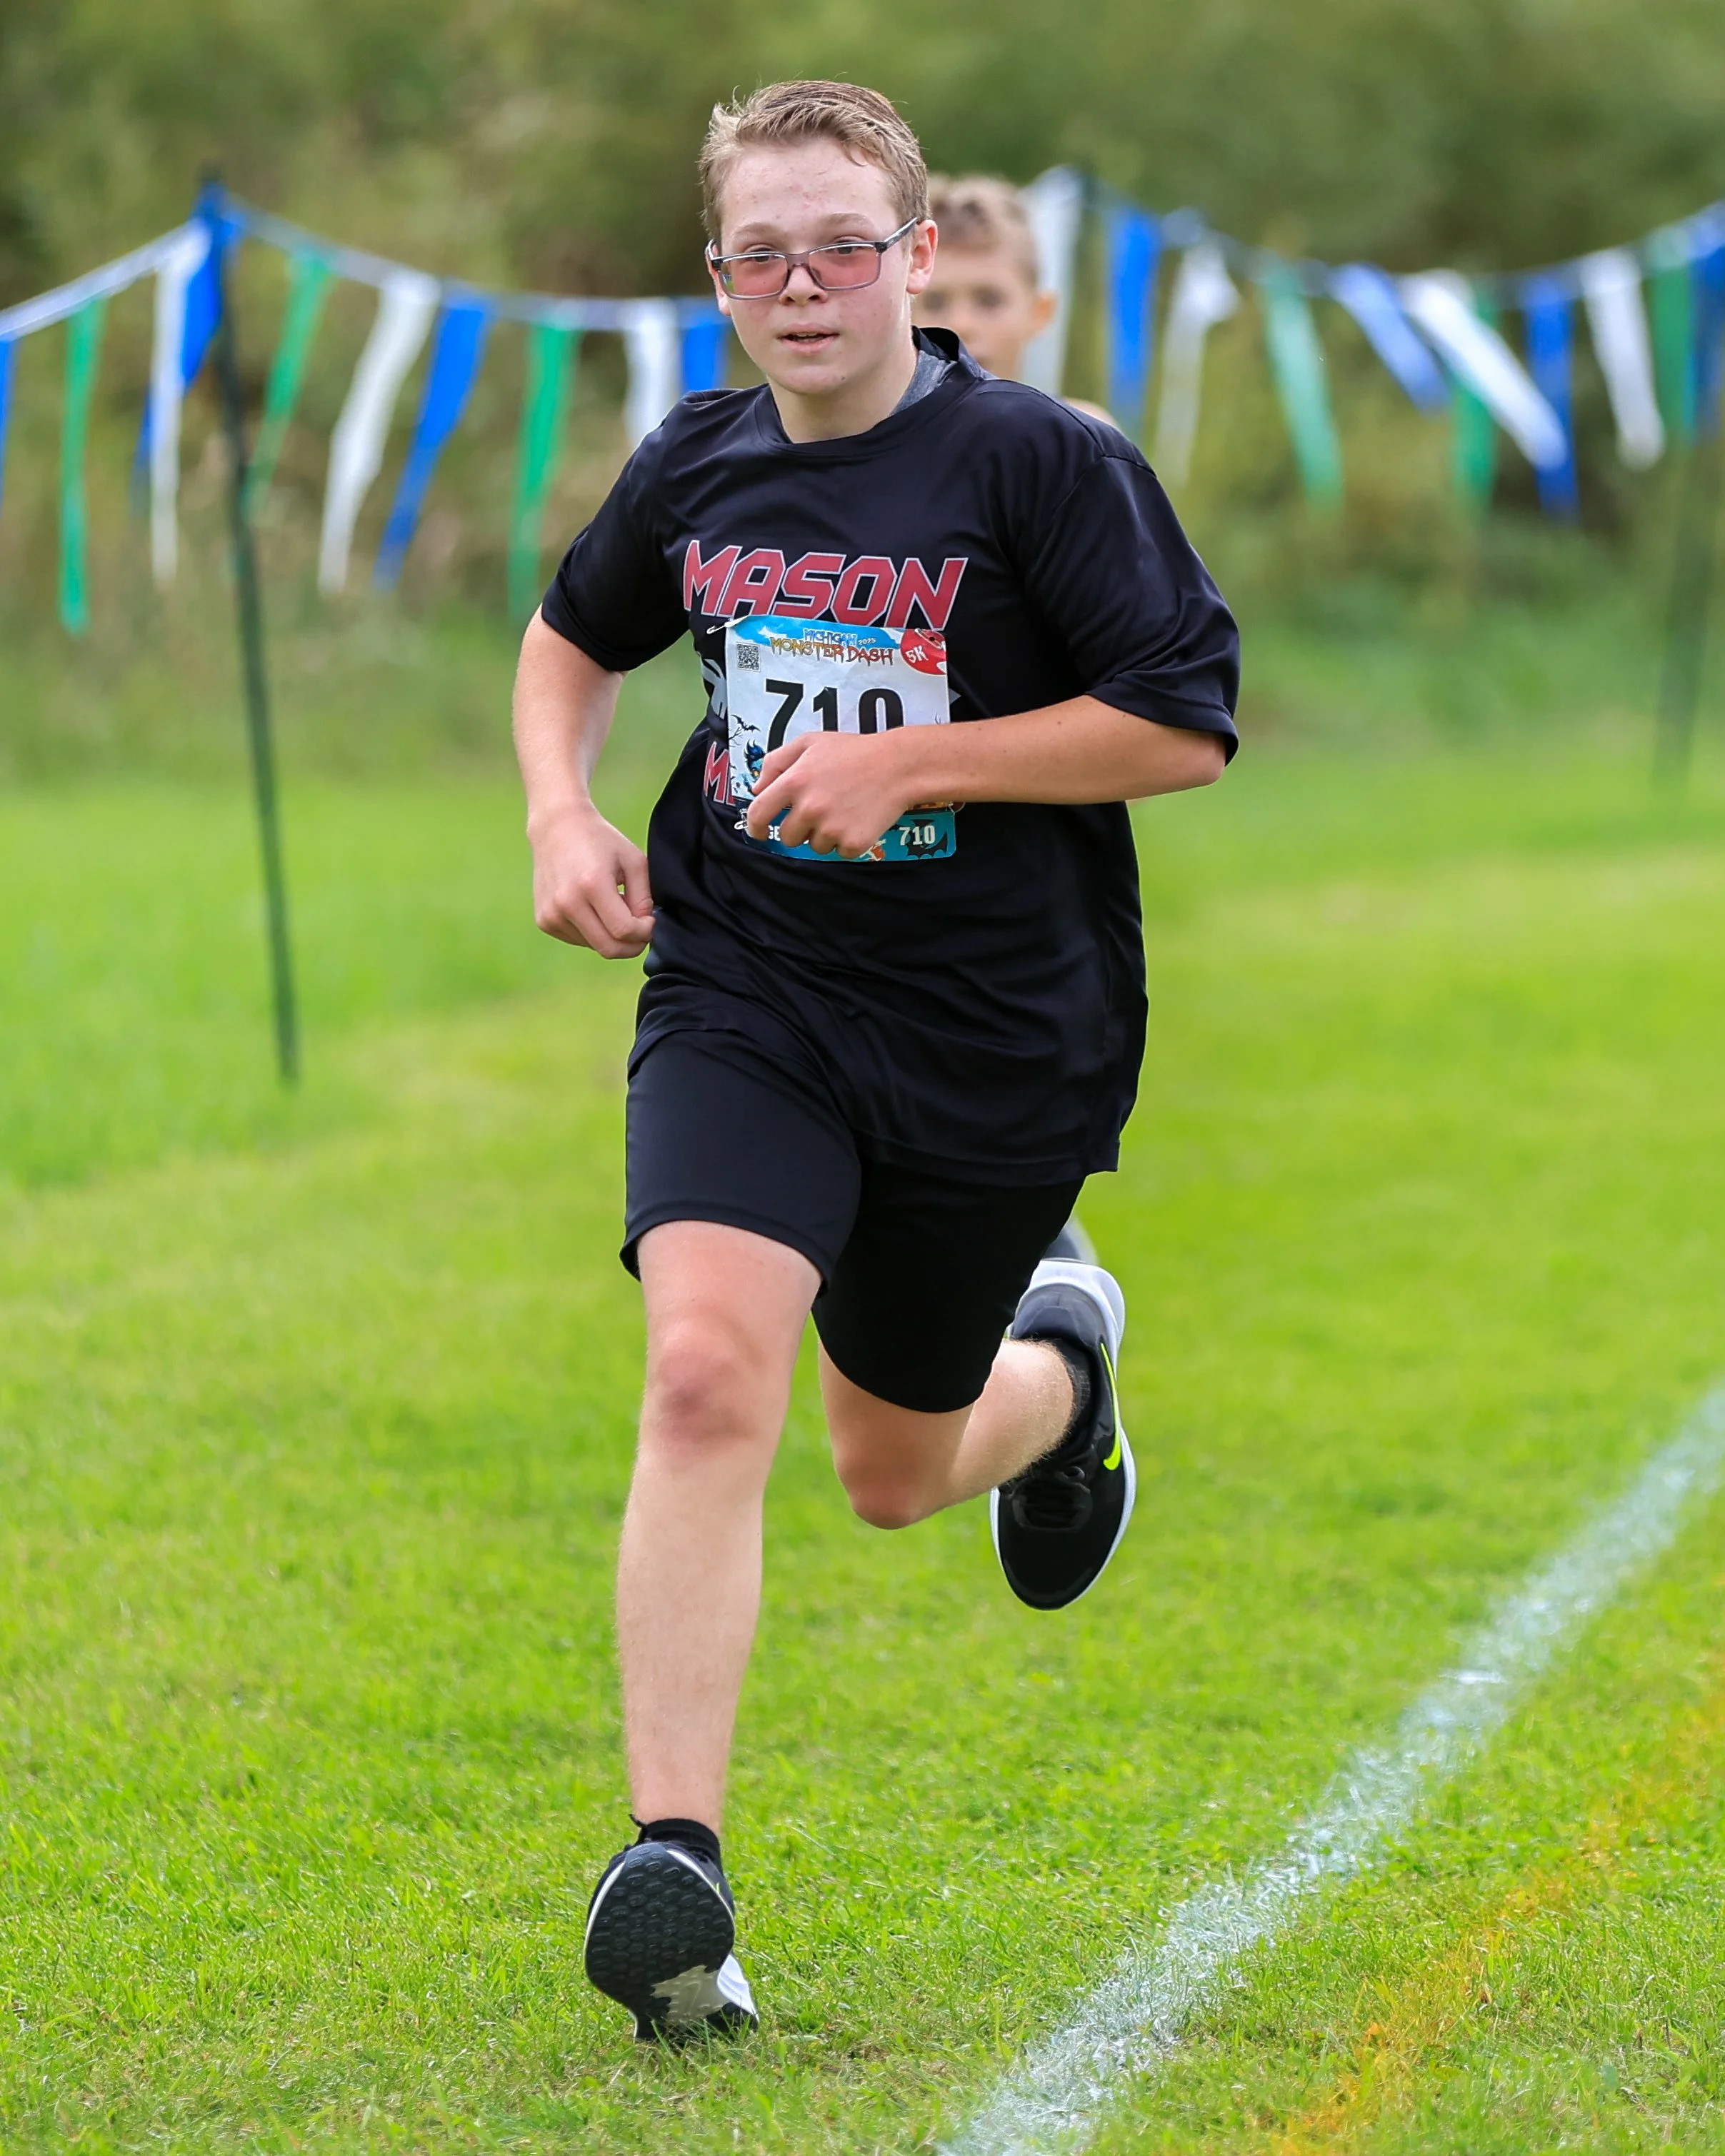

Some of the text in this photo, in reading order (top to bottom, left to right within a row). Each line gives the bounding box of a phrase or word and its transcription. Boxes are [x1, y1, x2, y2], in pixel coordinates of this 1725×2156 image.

[684, 540, 969, 631] MASON
[804, 628, 876, 646] MICHIGAN 2025
[770, 636, 894, 666] MONSTER DASH
[906, 645, 927, 663] 5K
[899, 825, 936, 846] 710
